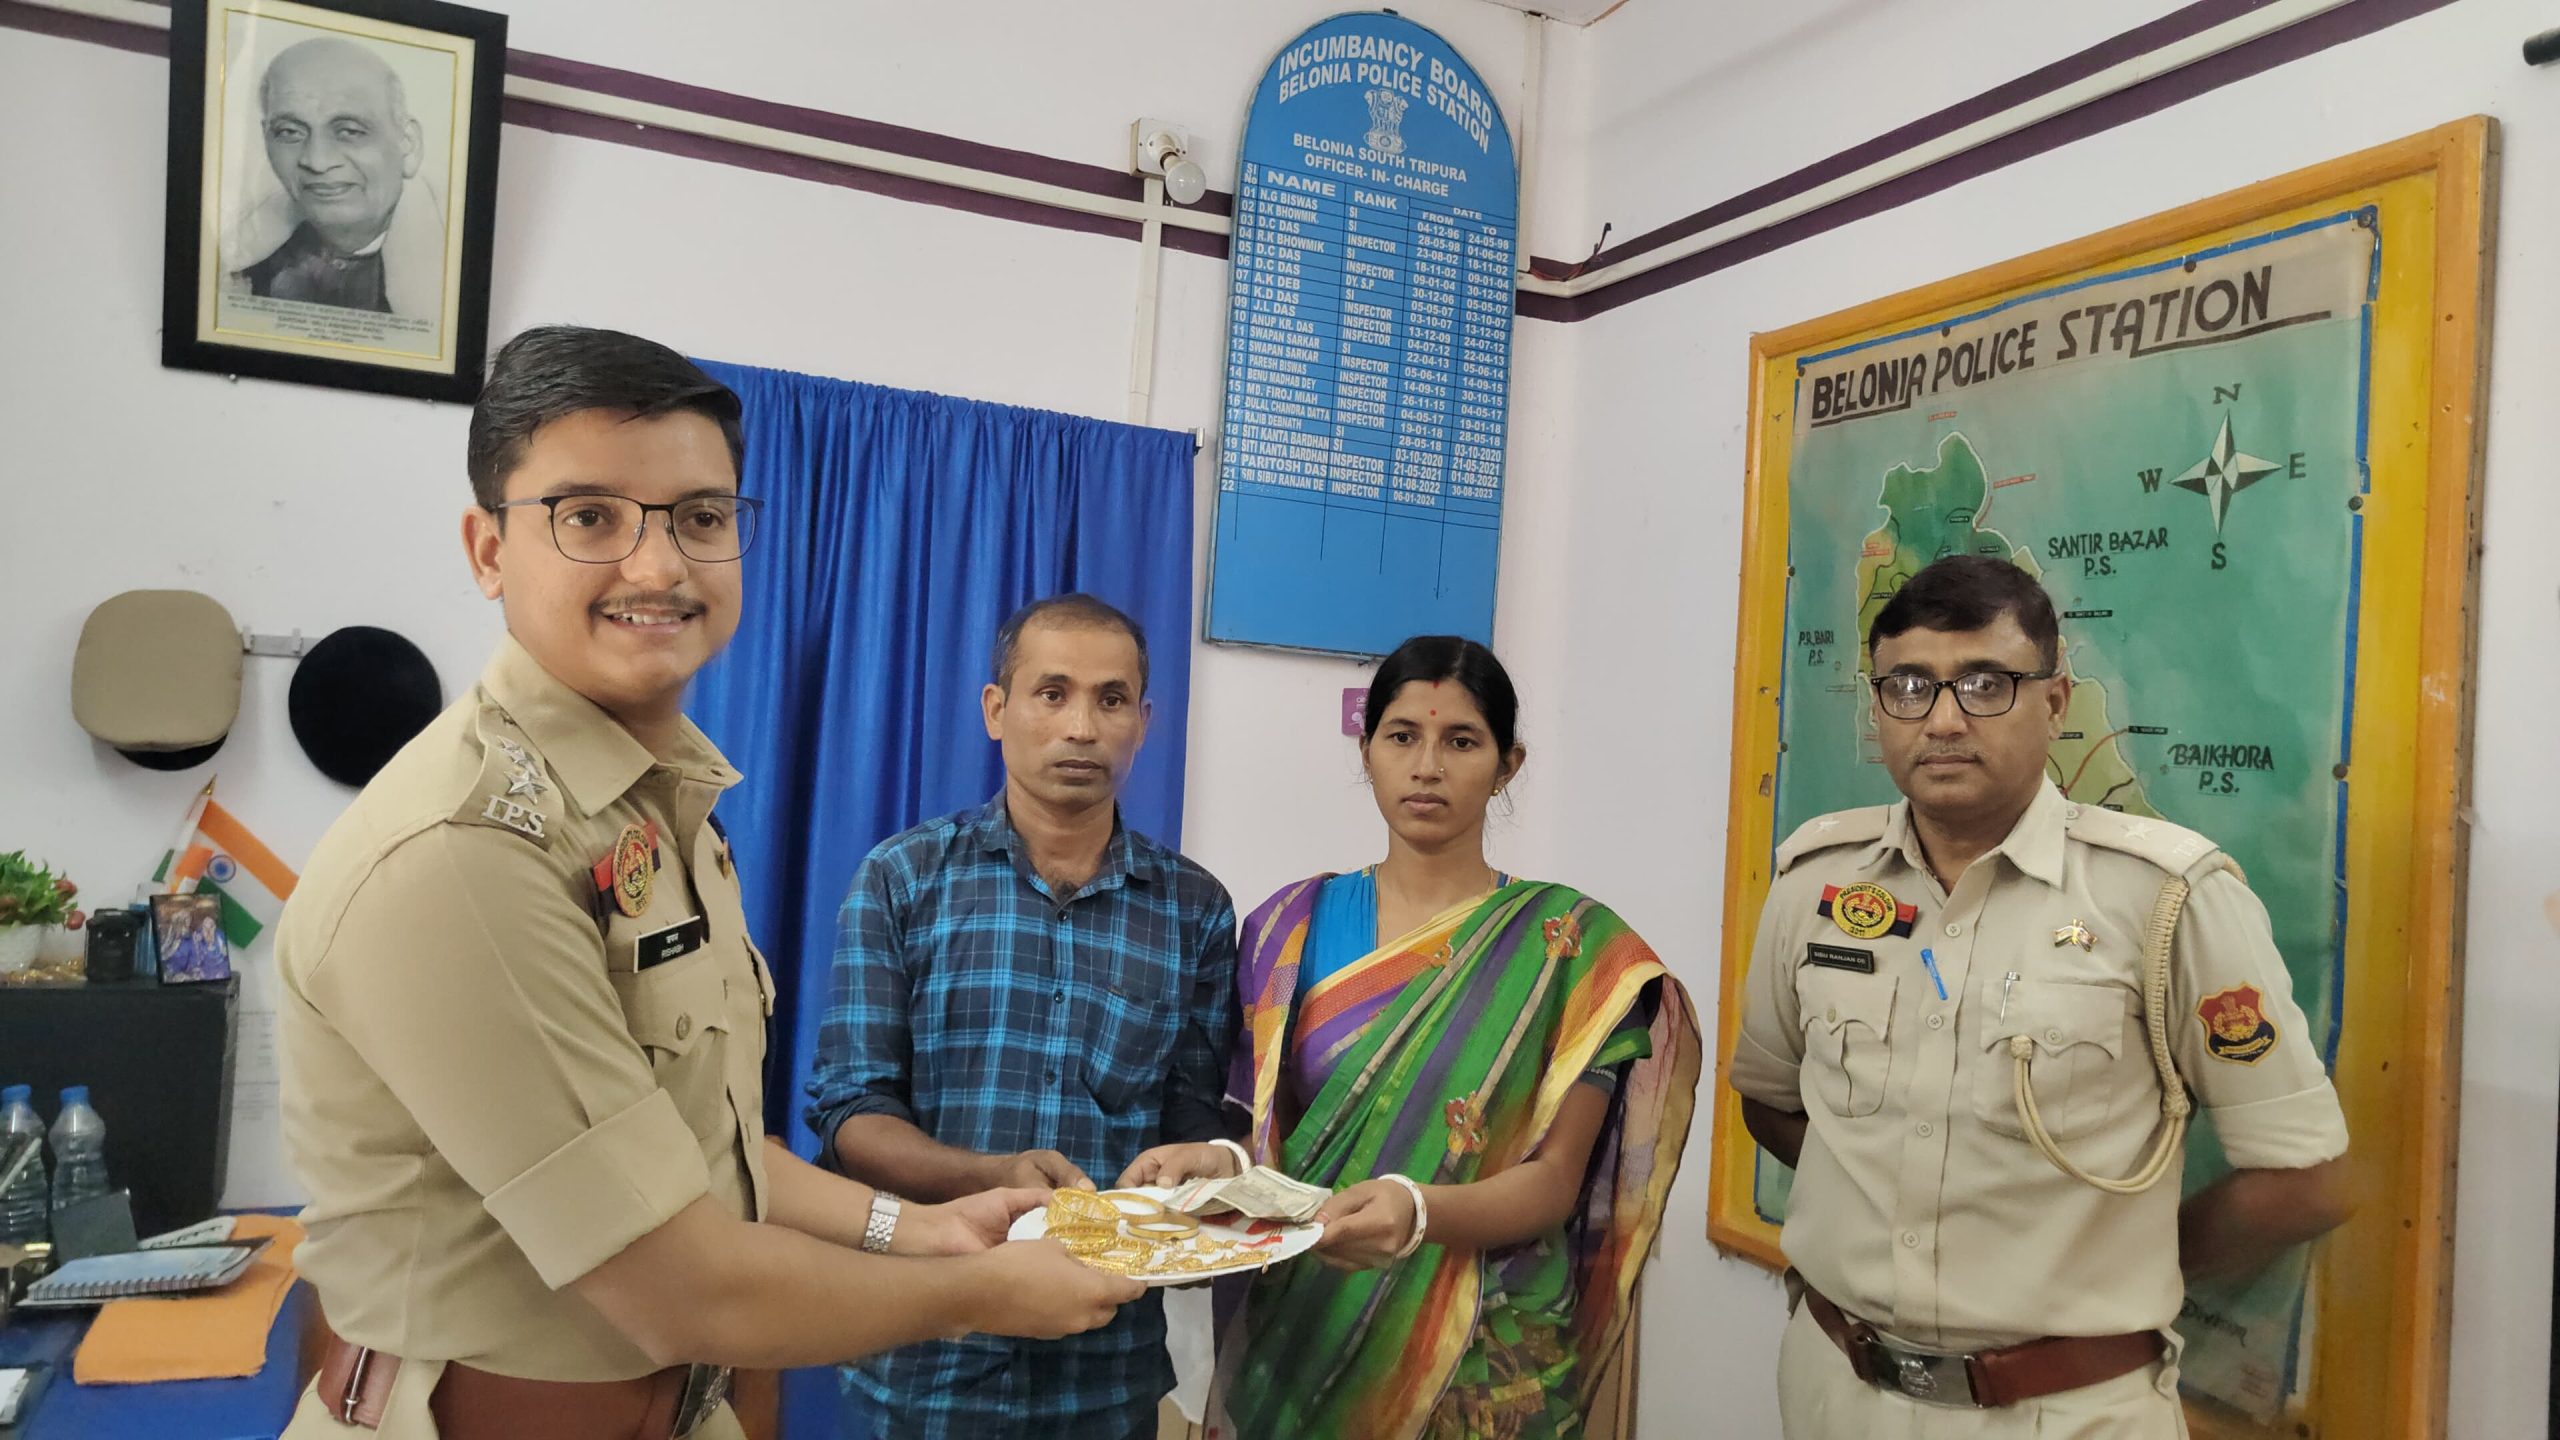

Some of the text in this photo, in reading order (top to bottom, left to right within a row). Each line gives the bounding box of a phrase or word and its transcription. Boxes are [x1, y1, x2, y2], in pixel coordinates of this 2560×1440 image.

[1279, 35, 1492, 130] INCUMBANCY BOARD
[1279, 62, 1489, 154] BELONIA POLICE STATION
[1293, 133, 1467, 183] BELONIA SOUTH TRIPURA
[1244, 186, 1255, 198] 01
[1280, 192, 1318, 210] BISWAS
[1350, 207, 1358, 218] SI
[1267, 171, 1336, 197] NAME
[1354, 191, 1397, 210] RANK
[1394, 174, 1449, 197] CHARGE
[1242, 200, 1357, 232] 02 SI
[1422, 212, 1454, 225] FROM
[1453, 208, 1482, 220] DATE
[1482, 226, 1497, 235] TO
[1237, 254, 1250, 267] 06
[1256, 258, 1274, 271] D.C
[1278, 262, 1300, 275] DAS
[1239, 241, 1251, 252] 05
[1257, 243, 1275, 256] D.C
[1279, 247, 1301, 261] DAS
[1346, 261, 1394, 281] INSPECTOR
[1240, 227, 1252, 239] 04
[1277, 234, 1324, 253] BHOWMIK
[1347, 249, 1355, 259] SI
[1415, 261, 1457, 279] 18-11-02
[1241, 214, 1508, 276] 03 D.C DAS INSPECTOR 18-11-02
[1236, 269, 1248, 280] 07
[1254, 272, 1273, 286] A.K
[1277, 276, 1300, 290] DEB
[1345, 289, 1354, 300] SI
[1235, 296, 1505, 354] 09 J.L DAS INSPECTOR 13-12-09 24-07-12
[1236, 283, 1248, 294] 08
[1254, 287, 1273, 299] K.D
[1277, 291, 1299, 304] DAS
[1344, 302, 1392, 320] INSPECTOR
[1465, 324, 1505, 340] 13-12-09
[1233, 325, 1449, 369] 11 SWAPAN SARKAR SI 22-04-13
[1234, 310, 1246, 322] 10
[1250, 314, 1276, 326] ANUP
[1296, 321, 1314, 334] DAS
[1342, 328, 1391, 346] INSPECTOR
[1463, 350, 1505, 366] 22-04-13
[1811, 265, 2272, 419] BELONIA POLICE STATION
[1231, 352, 1243, 364] 13
[1280, 360, 1307, 375] BISWAS
[1340, 371, 1388, 389] INSPECTOR
[1404, 380, 1446, 397] 14-09-15
[1461, 390, 1503, 407] 30-10-15
[1232, 339, 1503, 393] 12 SWAPAN SARKAR INSPECTOR 14-09-15
[1229, 366, 1242, 377] 14
[1302, 379, 1317, 390] DEY
[1338, 383, 1387, 402] INSPECTOR
[1461, 404, 1502, 421] 04-05-17
[1229, 380, 1240, 392] 15
[1266, 386, 1292, 401] FIROJ
[1296, 392, 1318, 405] MIAH
[1337, 397, 1385, 415] INSPECTOR
[1401, 409, 1444, 425] 04-05-17
[1460, 419, 1501, 434] 19-01-18
[2212, 383, 2242, 405] N
[1227, 409, 1239, 420] 17
[1336, 426, 1344, 437] SI
[1454, 443, 1501, 462] 03-10-2020
[1228, 394, 1240, 406] 16
[1307, 407, 1330, 421] DATTA
[1337, 410, 1385, 429] INSPECTOR
[1400, 423, 1443, 438] 19-01-18
[1224, 451, 1384, 486] 20 PARITOSH DAS INSPECTOR
[1225, 437, 1442, 481] 19 SITI KANTA BARDHAN INSPECTOR 21-05-2021
[1226, 423, 1500, 475] 18 SITI KANTA BARDHAN SI 03-10-2020 21-05-2021
[2289, 452, 2306, 480] E
[1222, 480, 1234, 491] 22
[1223, 467, 1235, 478] 21
[1257, 470, 1277, 484] SIBU
[1279, 473, 1311, 489] RANJAN
[1314, 479, 1324, 491] DE
[1332, 481, 1379, 499] INSPECTOR
[2137, 468, 2163, 493] W
[2048, 527, 2169, 558] SANTIR BAZAR
[2211, 543, 2226, 570] S
[2167, 743, 2274, 770] BAIKHORA
[481, 794, 547, 838] IPS
